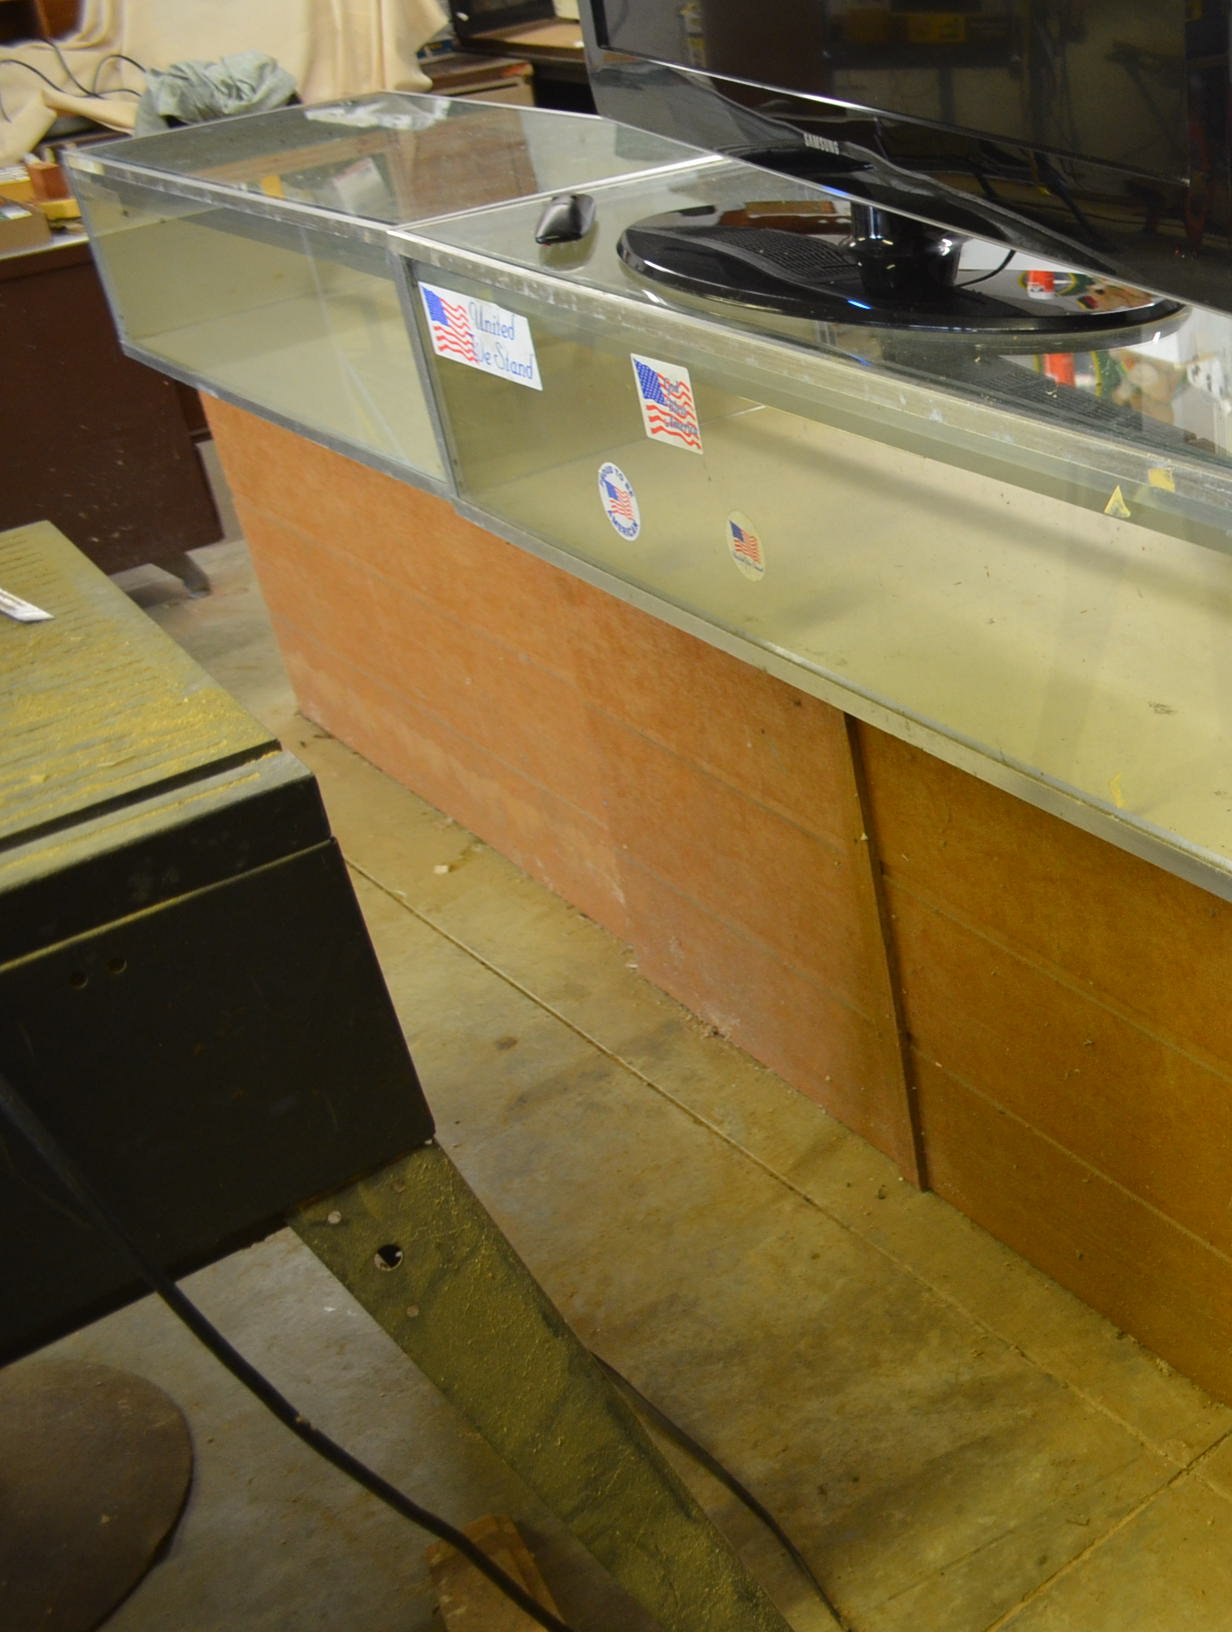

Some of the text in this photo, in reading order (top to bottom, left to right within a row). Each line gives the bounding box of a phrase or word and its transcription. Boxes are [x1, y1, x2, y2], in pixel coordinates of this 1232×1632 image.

[803, 132, 840, 155] SAMSUNG
[468, 301, 515, 340] United
[494, 342, 534, 380] Stand
